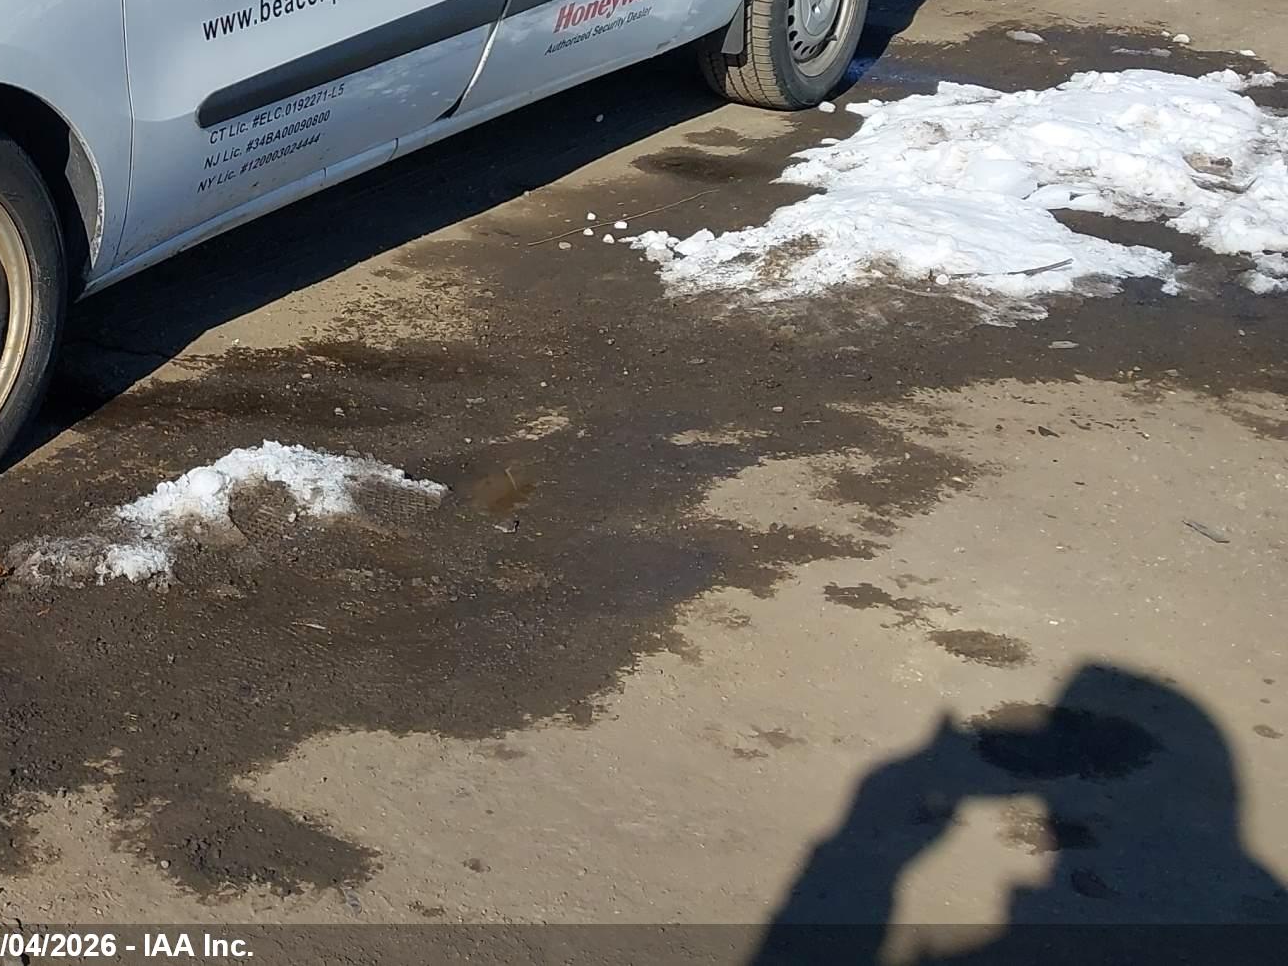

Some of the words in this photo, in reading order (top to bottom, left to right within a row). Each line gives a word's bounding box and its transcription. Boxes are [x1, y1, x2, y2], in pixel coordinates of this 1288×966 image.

[543, 26, 593, 57] Authorized
[593, 13, 626, 38] Security
[626, 6, 653, 27] Dealer
[209, 127, 227, 145] CT
[229, 120, 249, 138] Lic.
[252, 83, 345, 129] #ELC.0192271-L5
[204, 155, 221, 170] NJ
[222, 146, 242, 164] Lic.
[196, 176, 217, 194] NY
[216, 168, 237, 185] Lic.
